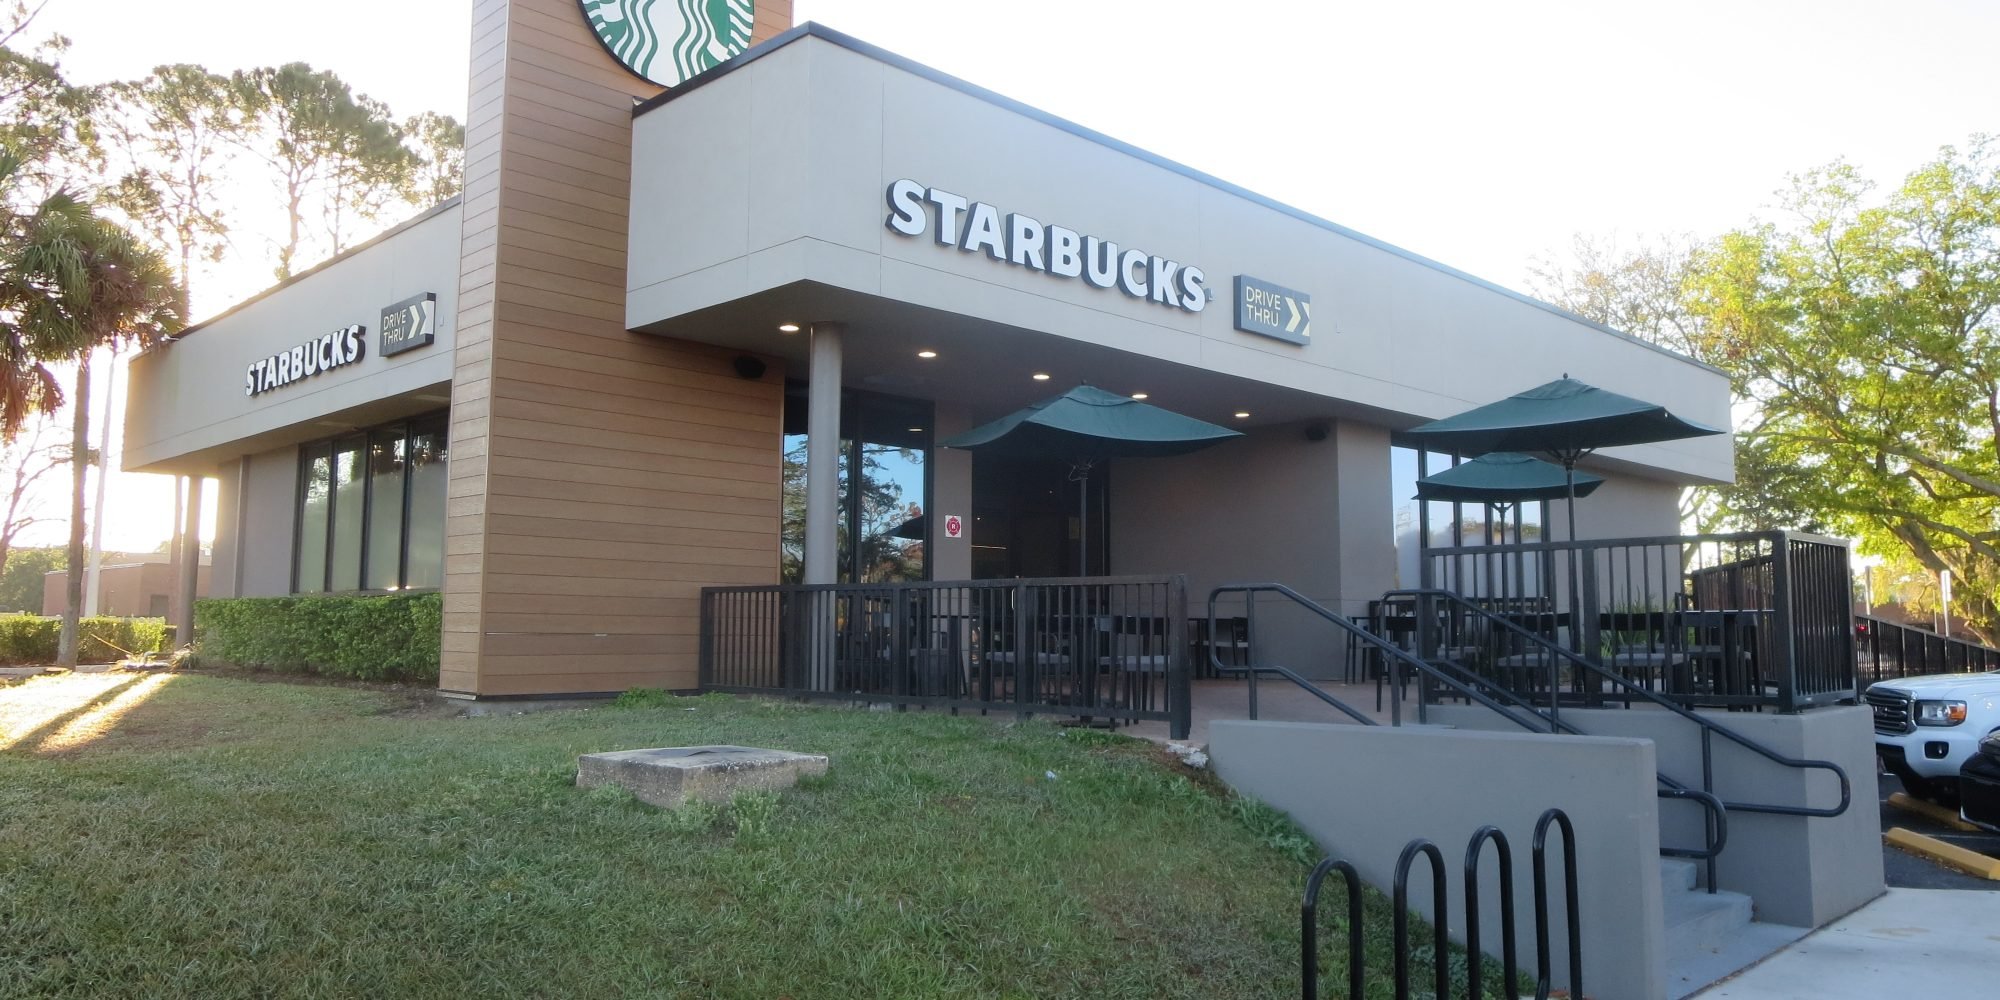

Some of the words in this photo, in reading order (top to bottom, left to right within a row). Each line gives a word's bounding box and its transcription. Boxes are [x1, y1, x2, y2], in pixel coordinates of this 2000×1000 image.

[886, 178, 1206, 312] STARBUCKS
[1246, 286, 1281, 310] DRIVE
[384, 309, 407, 330] DRIVE
[1246, 303, 1279, 327] THRU
[384, 328, 404, 346] THRU
[245, 324, 360, 396] STARBUCKS
